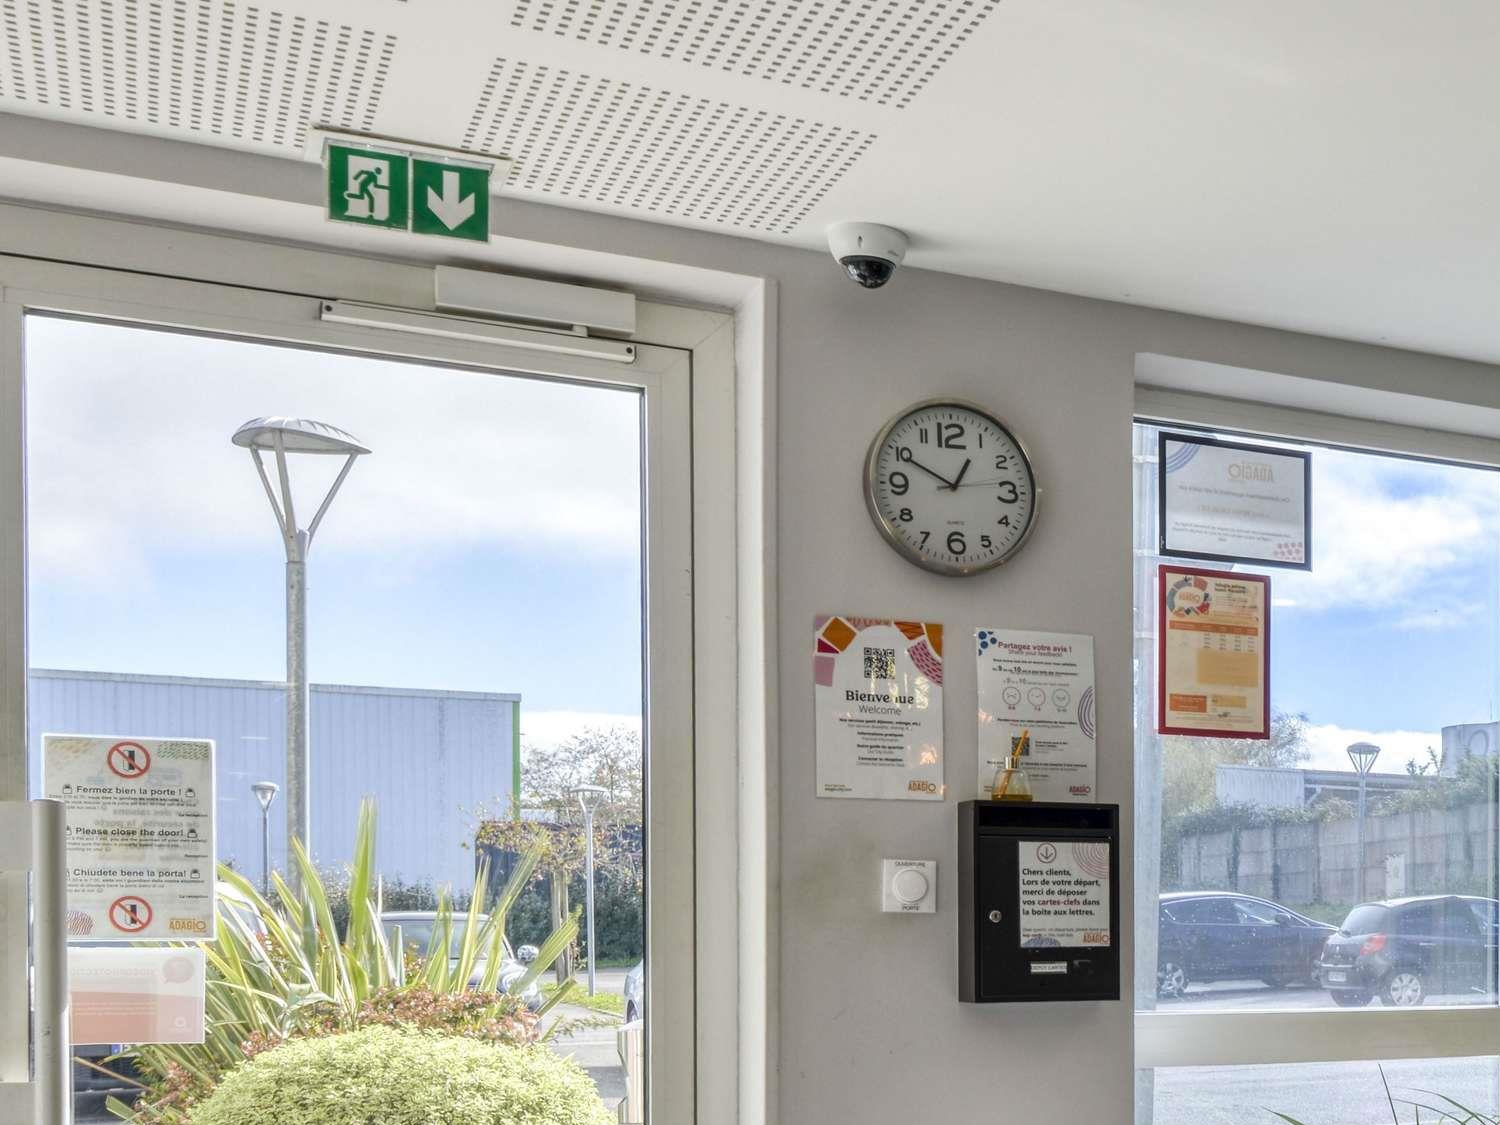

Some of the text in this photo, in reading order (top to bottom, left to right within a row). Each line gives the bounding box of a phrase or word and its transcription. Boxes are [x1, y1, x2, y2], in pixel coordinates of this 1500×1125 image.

[920, 428, 928, 444] 11
[937, 423, 966, 449] 12
[896, 447, 912, 462] 10
[995, 455, 1009, 470] 2
[889, 472, 909, 496] 9
[997, 481, 1019, 504] 3
[899, 507, 913, 522] 8
[997, 515, 1010, 527] 4
[919, 531, 930, 545] 7
[947, 531, 967, 555] 6
[981, 535, 992, 548] 5
[998, 642, 1031, 651] Partagez
[858, 704, 902, 716] Welcome
[77, 786, 112, 794] Fermez
[116, 786, 136, 795] bien
[150, 787, 175, 796] porte
[908, 780, 936, 792] ADAGIO
[76, 827, 184, 837] Please close the door!
[73, 868, 117, 877] Chiudete
[121, 869, 144, 877] bene
[159, 869, 186, 879] porta!
[1022, 868, 1071, 877] Chers clients,
[1073, 879, 1101, 888] départ,
[1057, 889, 1087, 897] déposer
[1069, 908, 1095, 916] lettres.
[169, 918, 206, 931] ADAGIO
